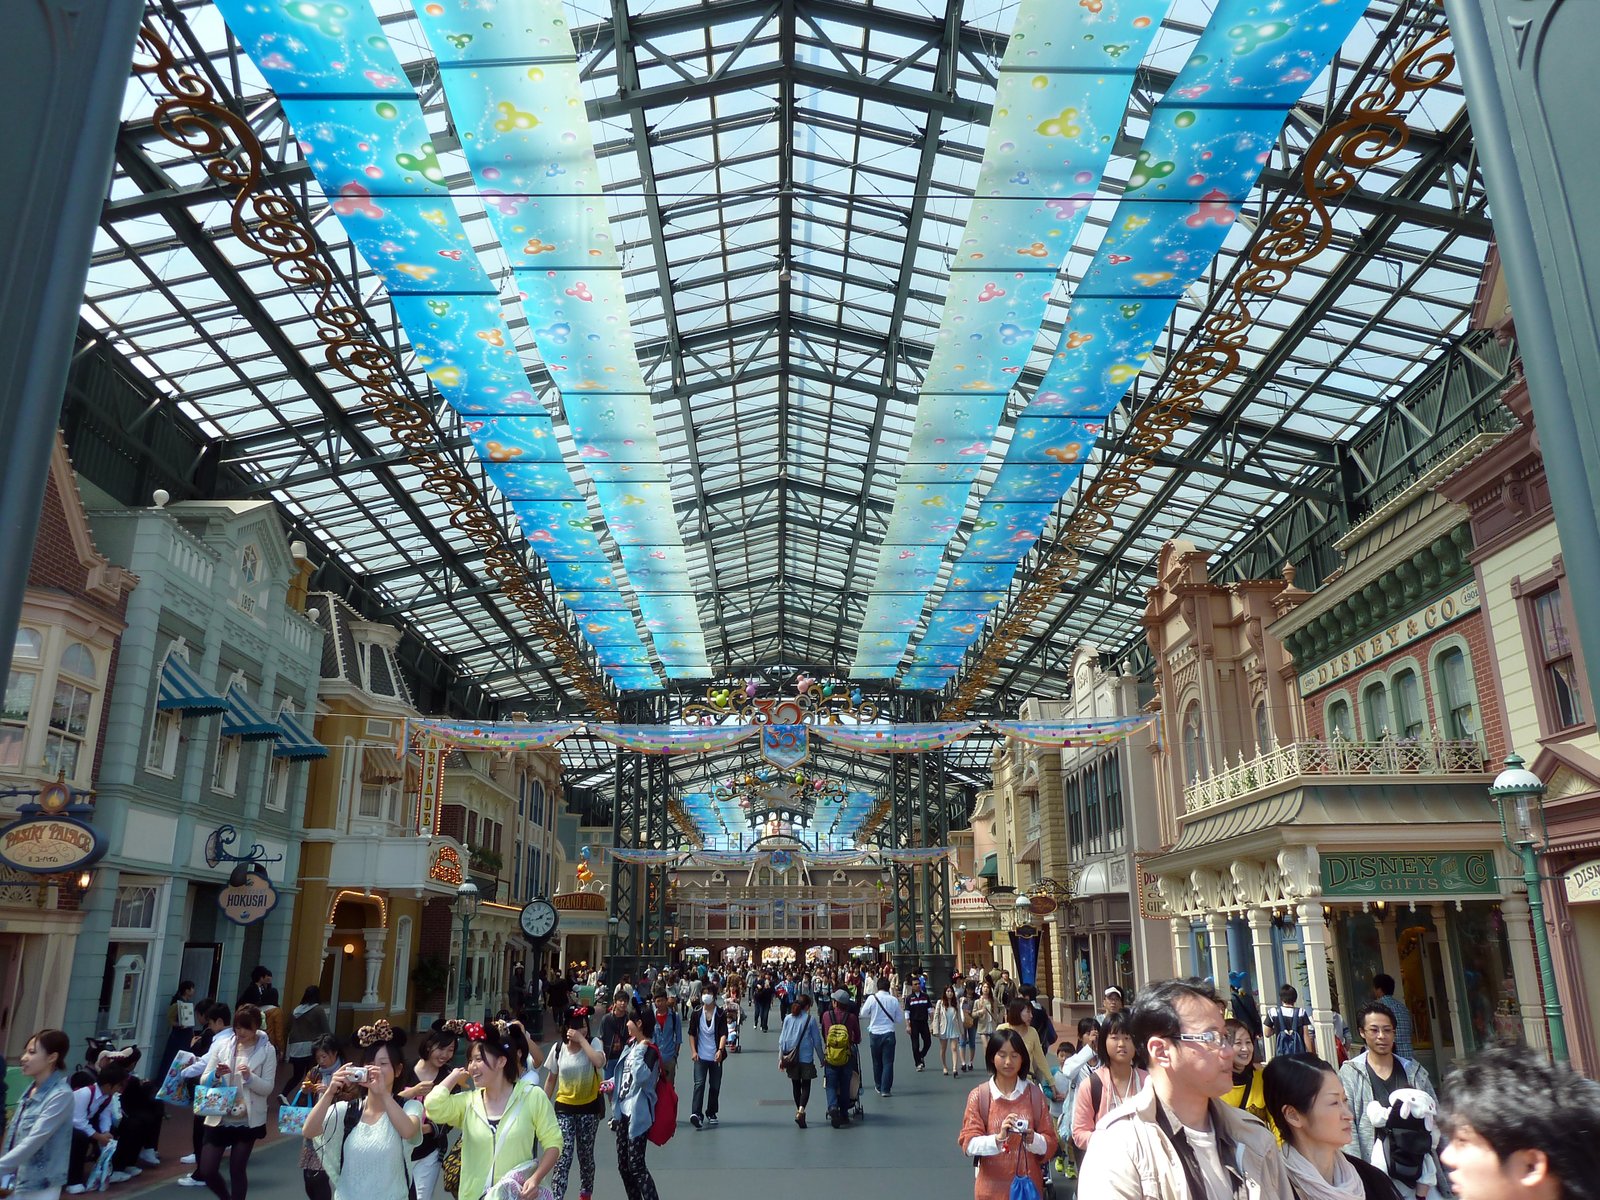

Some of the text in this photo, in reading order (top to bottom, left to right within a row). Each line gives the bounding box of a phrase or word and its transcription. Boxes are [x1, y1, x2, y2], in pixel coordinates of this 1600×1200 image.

[241, 593, 255, 614] 1897
[1464, 589, 1479, 603] 1901
[1318, 626, 1400, 686] DISNEY
[1407, 618, 1419, 639] &
[767, 731, 797, 749] 30
[422, 736, 437, 827] ARCADE
[5, 823, 92, 853] PASTRY PALACE
[1326, 855, 1437, 887] DISNEY
[1380, 877, 1440, 892] GIFTS
[226, 894, 268, 908] HOKUSAI
[554, 895, 581, 909] GRAND
